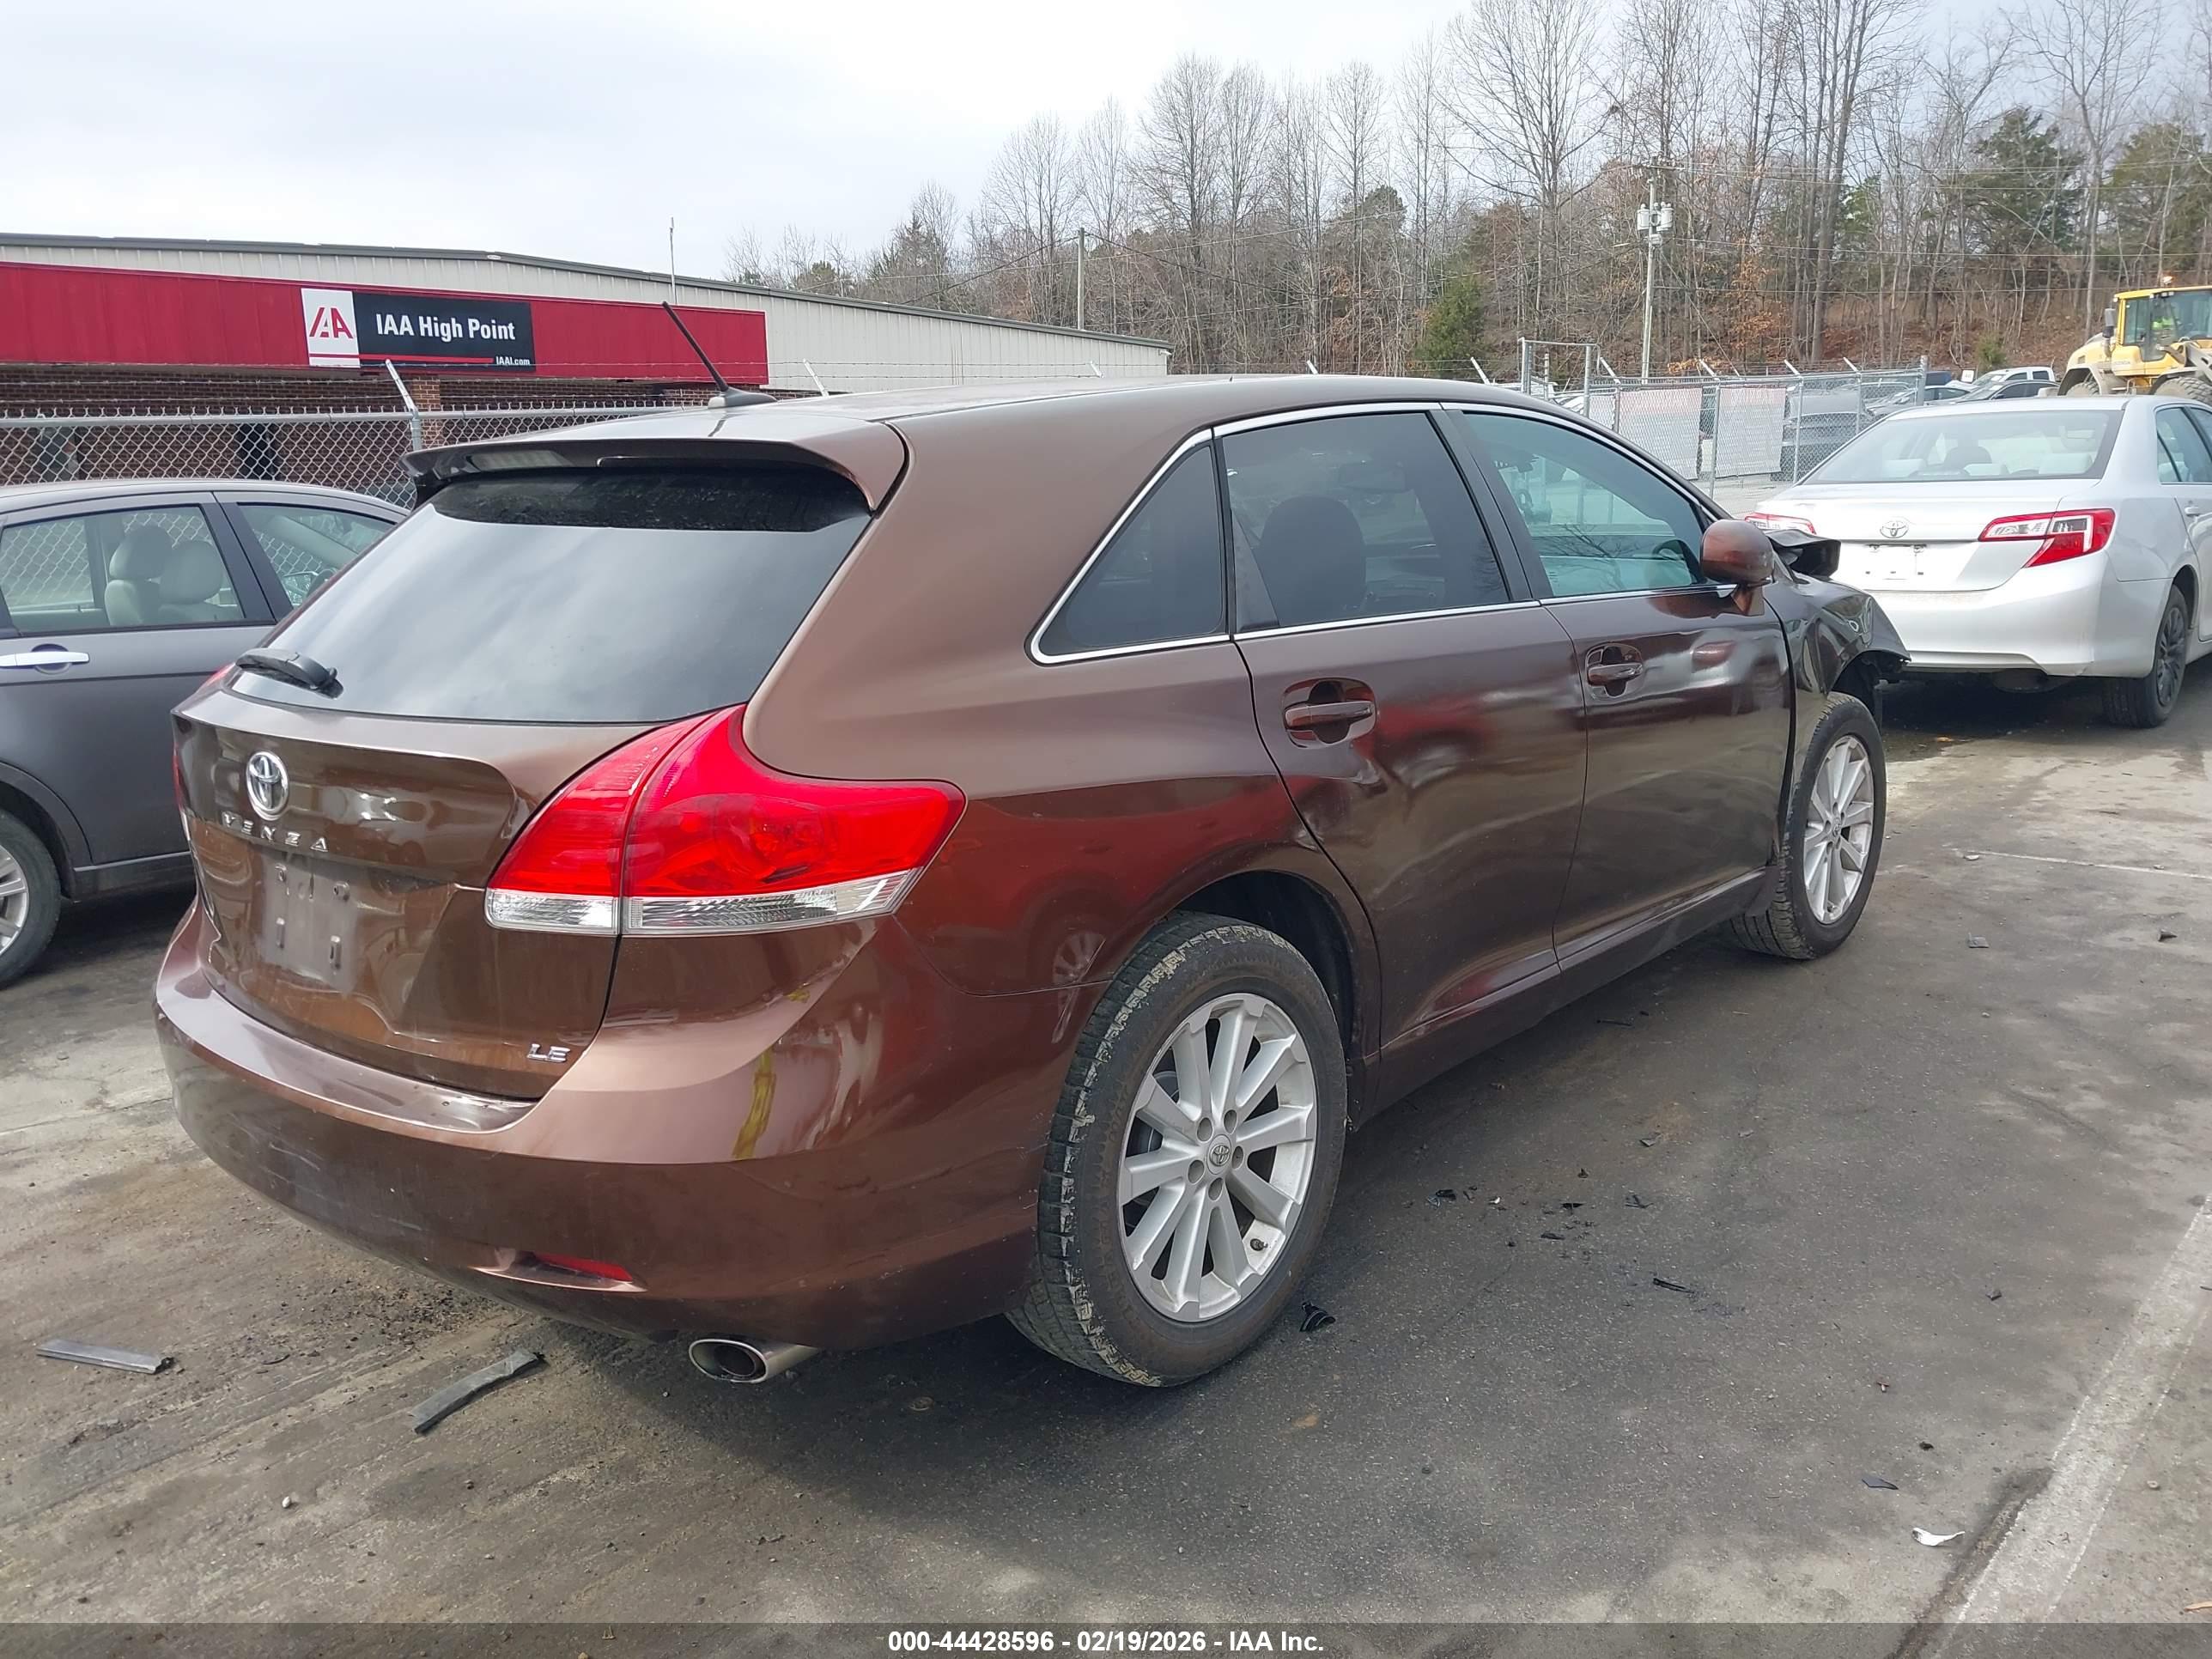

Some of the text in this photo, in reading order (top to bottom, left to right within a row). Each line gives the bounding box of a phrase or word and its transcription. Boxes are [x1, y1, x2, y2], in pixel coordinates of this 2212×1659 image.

[376, 313, 516, 343] IAA High Point
[495, 356, 531, 366] IAAI.com
[222, 811, 329, 853] VENZA
[526, 1043, 571, 1063] LE
